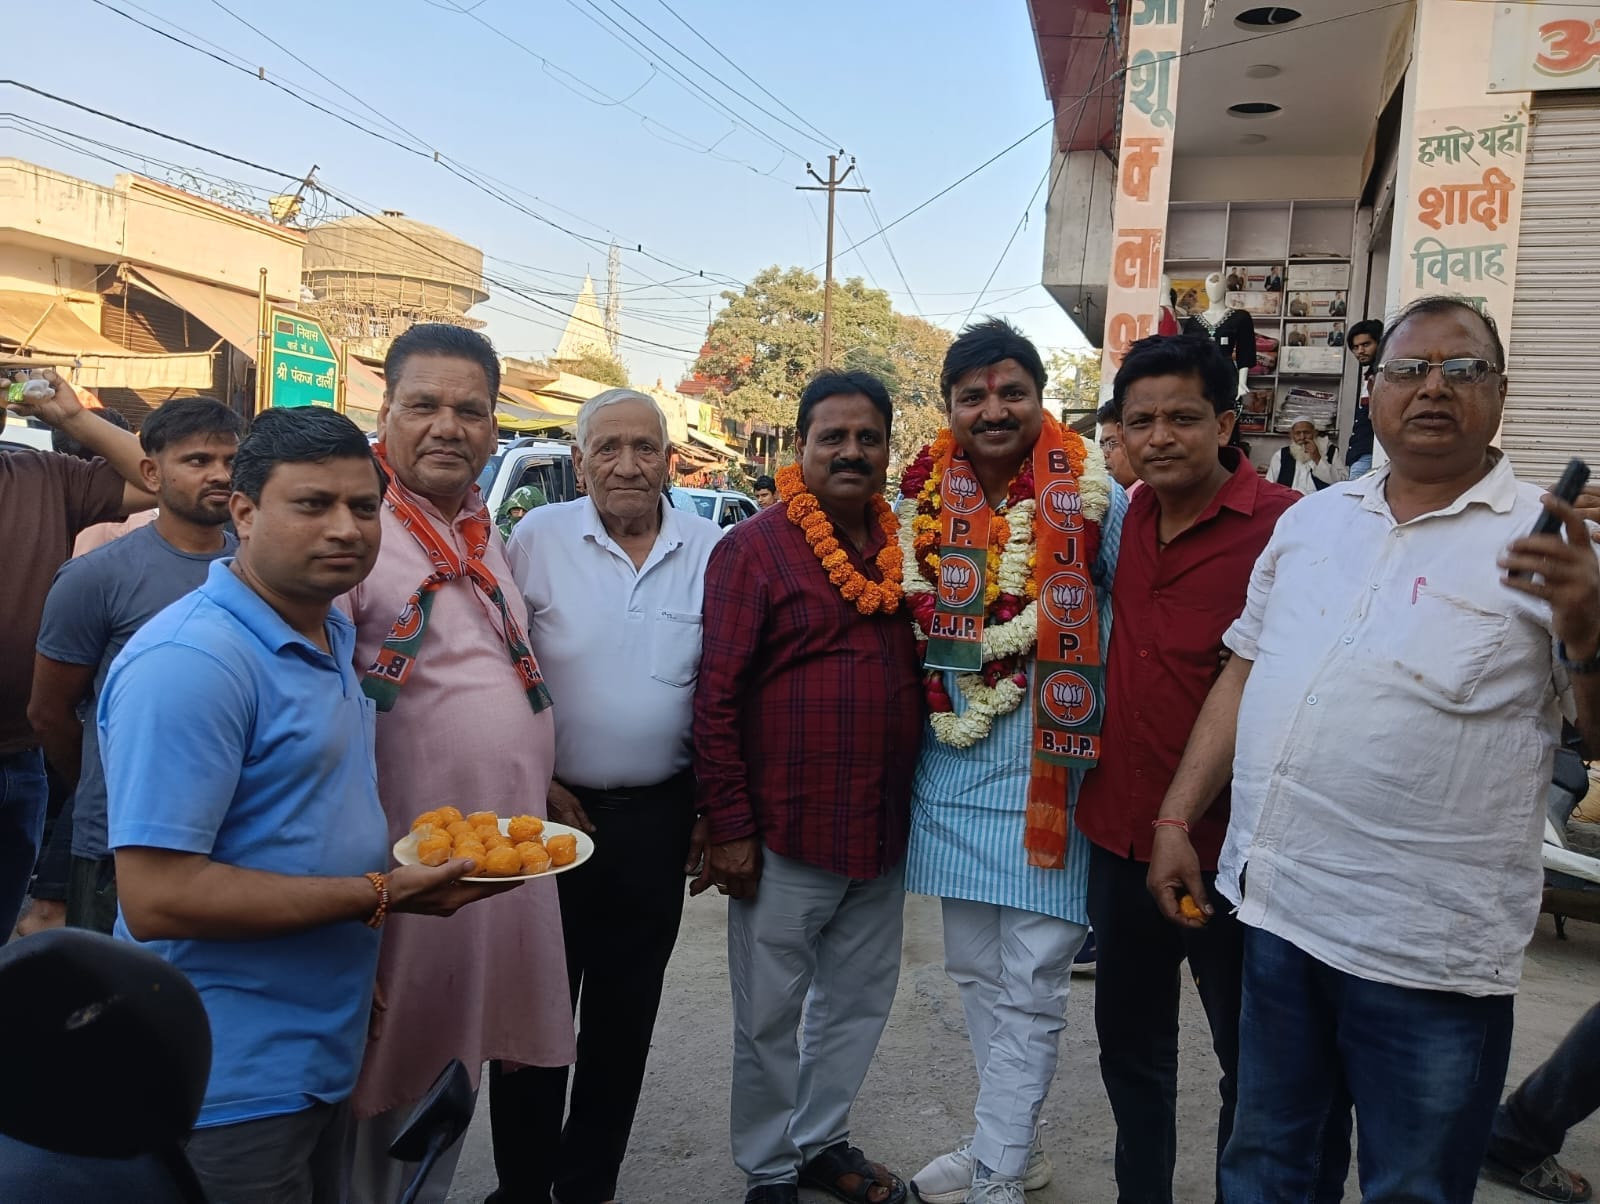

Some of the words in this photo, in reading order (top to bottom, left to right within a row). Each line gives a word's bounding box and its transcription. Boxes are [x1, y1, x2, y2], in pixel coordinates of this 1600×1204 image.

[1418, 126, 1480, 166] हमारे
[1418, 167, 1516, 231] शादी
[1410, 237, 1509, 289] विवाह
[296, 324, 318, 342] निवास
[276, 362, 288, 381] श्री
[291, 366, 313, 386] पंकज
[930, 613, 977, 640] B.J.P.
[1042, 729, 1096, 757] B.J.P.
